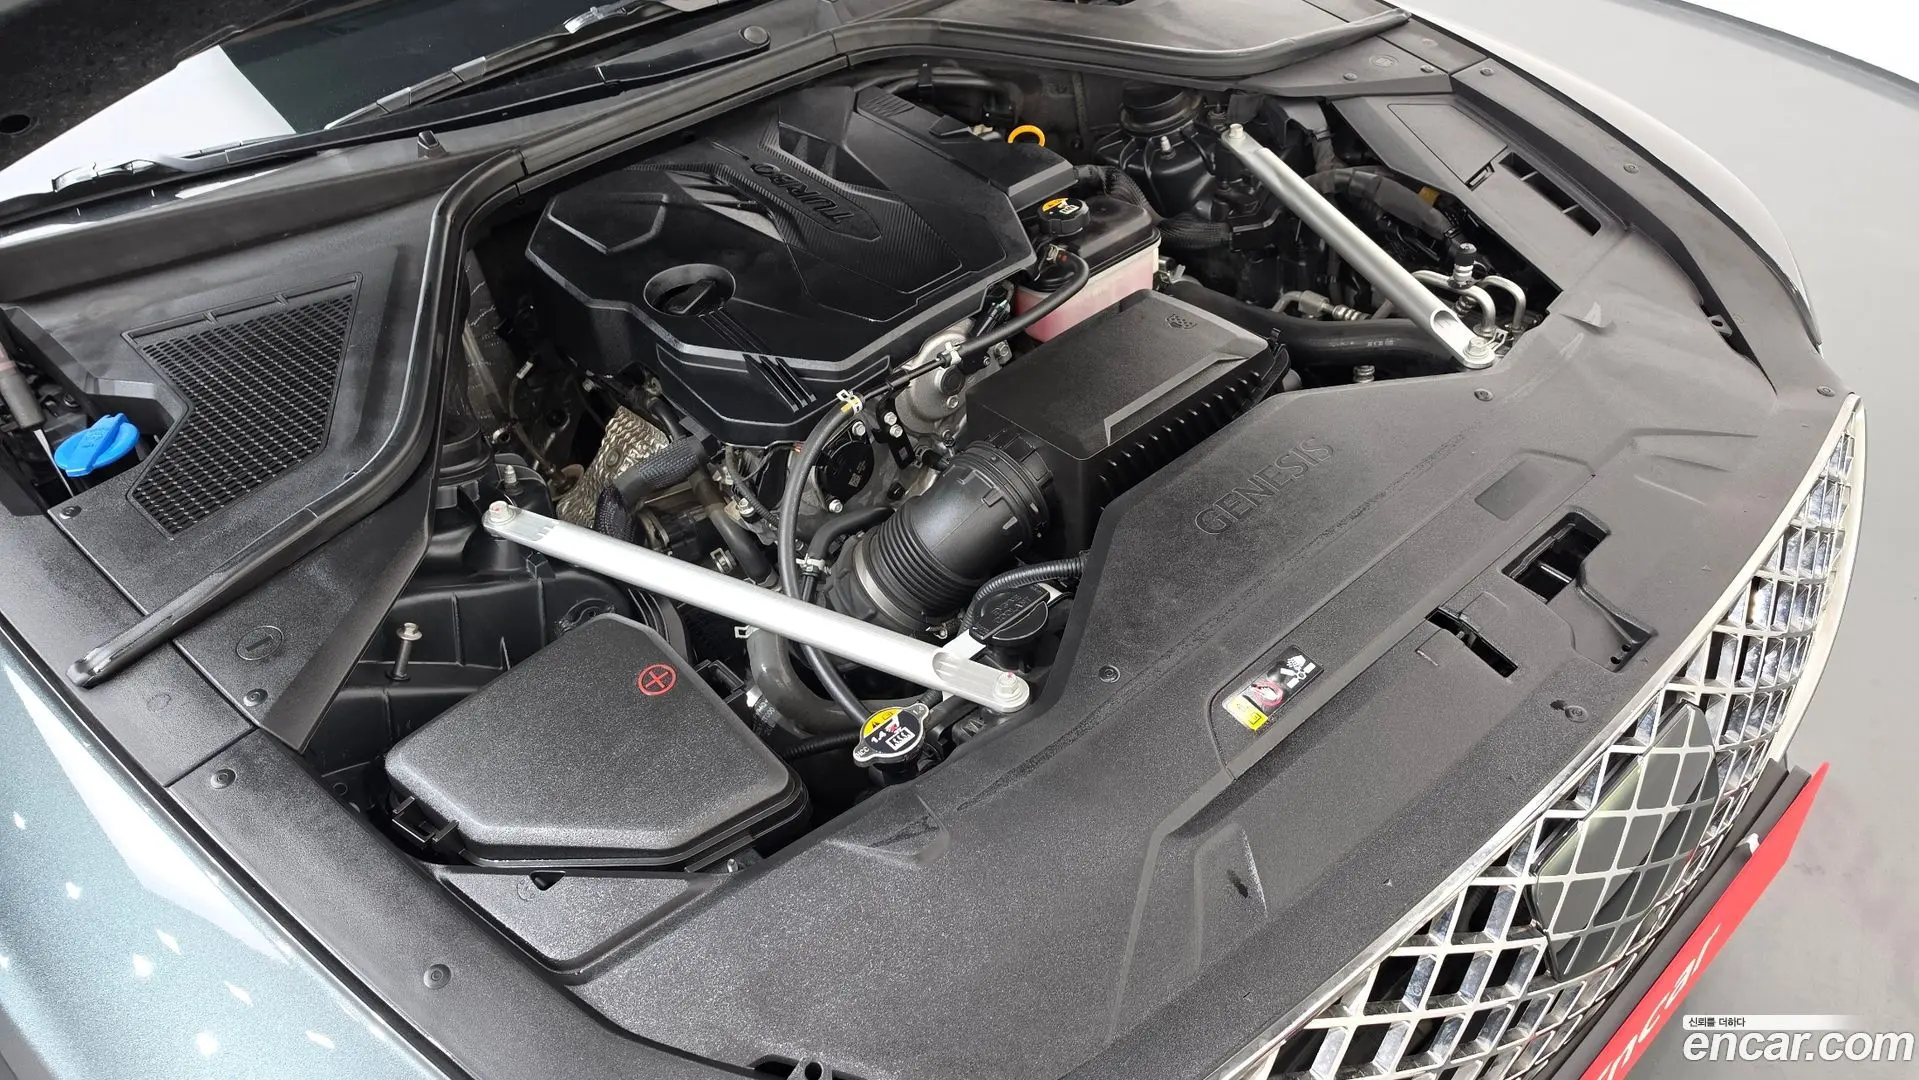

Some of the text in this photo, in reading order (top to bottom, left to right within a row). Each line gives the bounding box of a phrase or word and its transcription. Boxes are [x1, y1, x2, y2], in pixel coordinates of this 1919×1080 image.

[751, 162, 855, 225] TURBO
[1195, 436, 1334, 535] GENESIS
[871, 730, 887, 743] 1.4
[1598, 923, 1721, 1080] ncar
